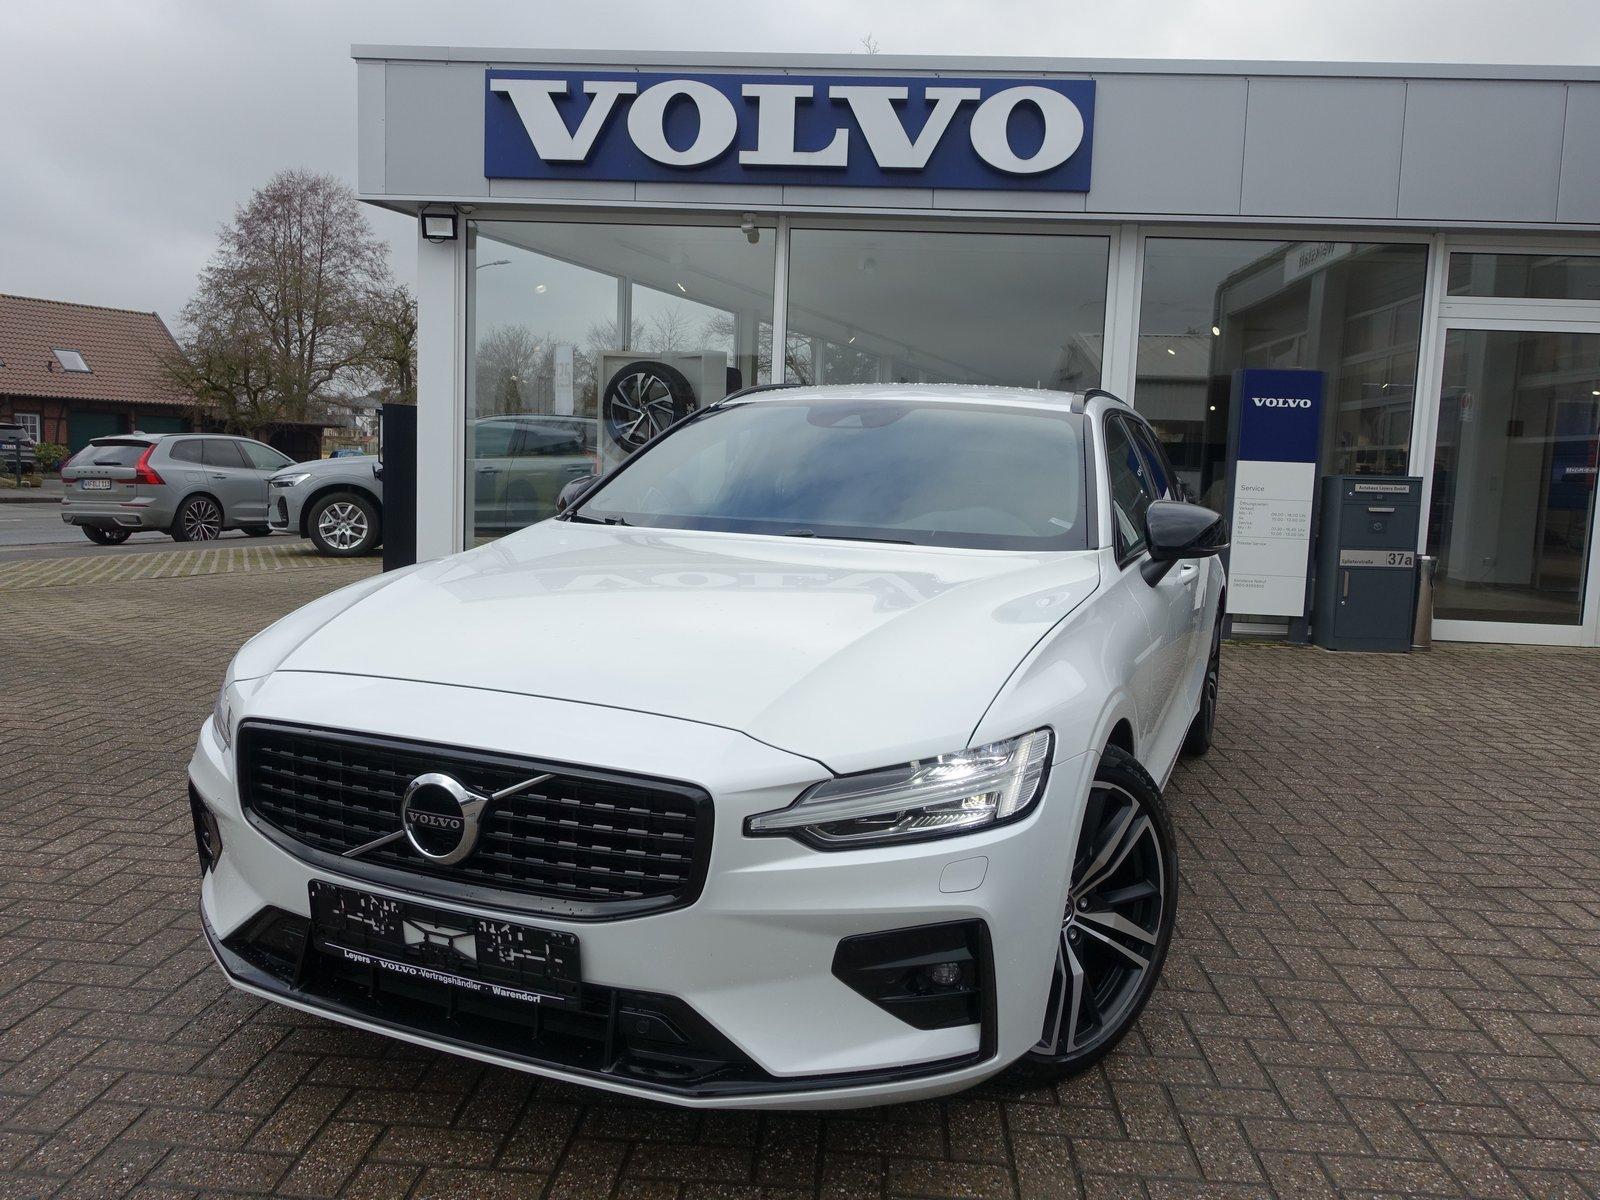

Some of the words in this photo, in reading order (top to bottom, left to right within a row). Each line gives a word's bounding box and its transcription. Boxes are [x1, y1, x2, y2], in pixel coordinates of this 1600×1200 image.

[489, 78, 1084, 175] VOLVO
[1252, 397, 1312, 409] VOLVO
[1240, 484, 1265, 492] Service
[1388, 553, 1413, 566] 37a
[408, 811, 460, 829] VOLVO
[344, 950, 371, 964] Leyers
[379, 960, 417, 975] VOLVO
[492, 986, 541, 1004] Warendorf
